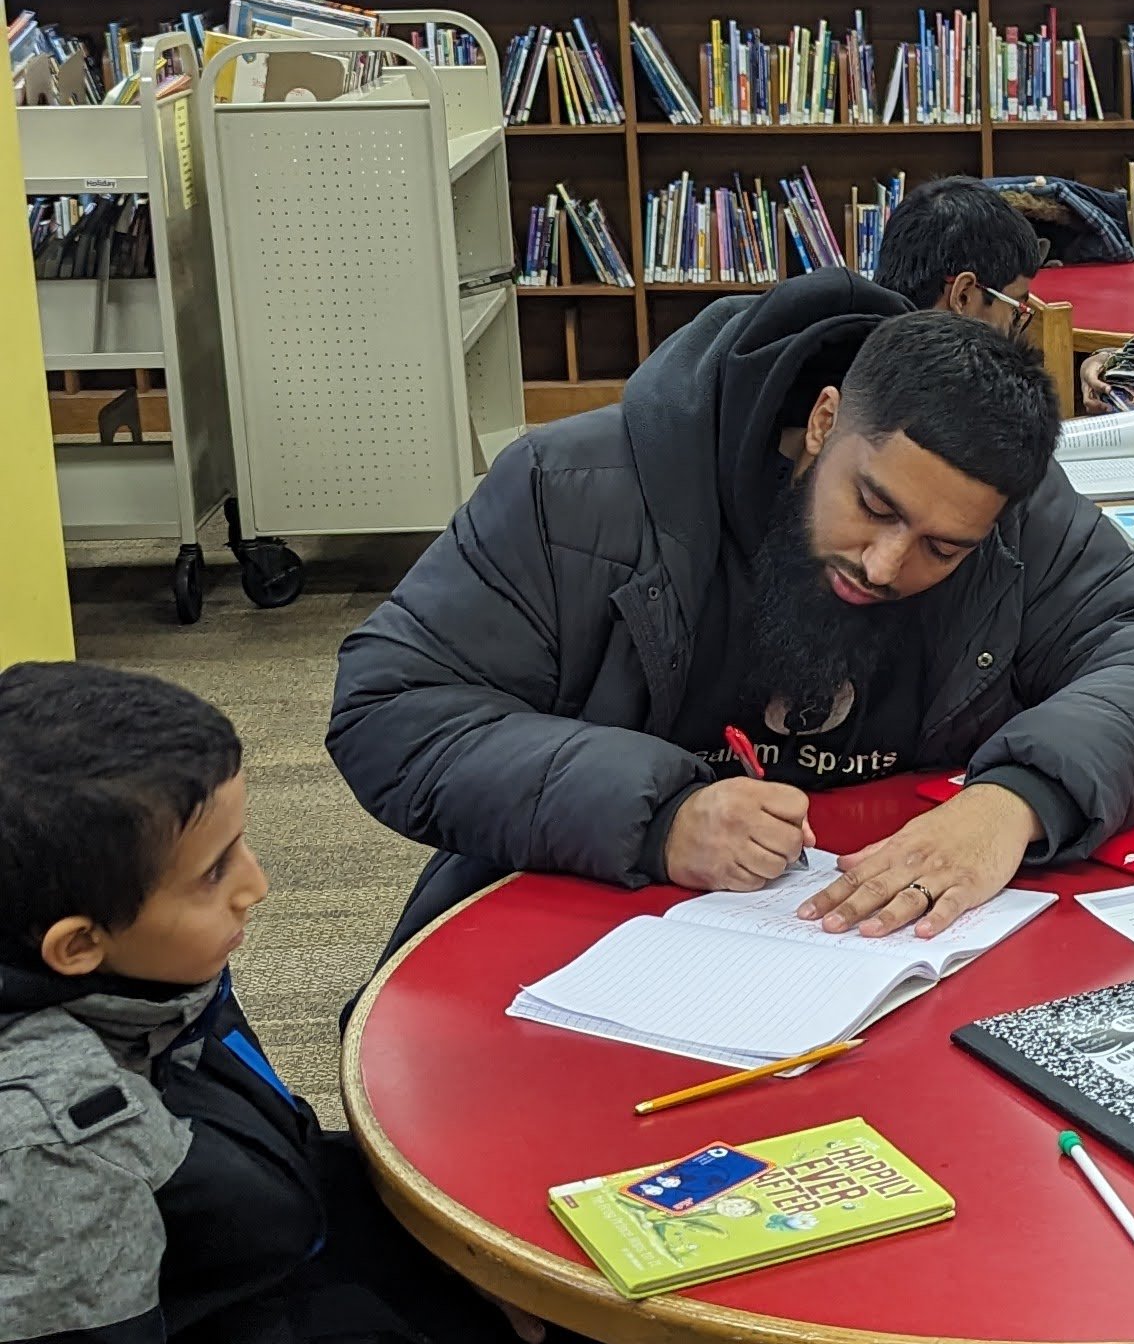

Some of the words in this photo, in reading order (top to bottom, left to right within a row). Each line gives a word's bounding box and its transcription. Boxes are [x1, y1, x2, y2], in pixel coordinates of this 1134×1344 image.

[798, 744, 898, 774] Sports
[753, 1170, 821, 1216] AFTER
[784, 1157, 869, 1205] EVER
[826, 1145, 923, 1199] HAPPILY
